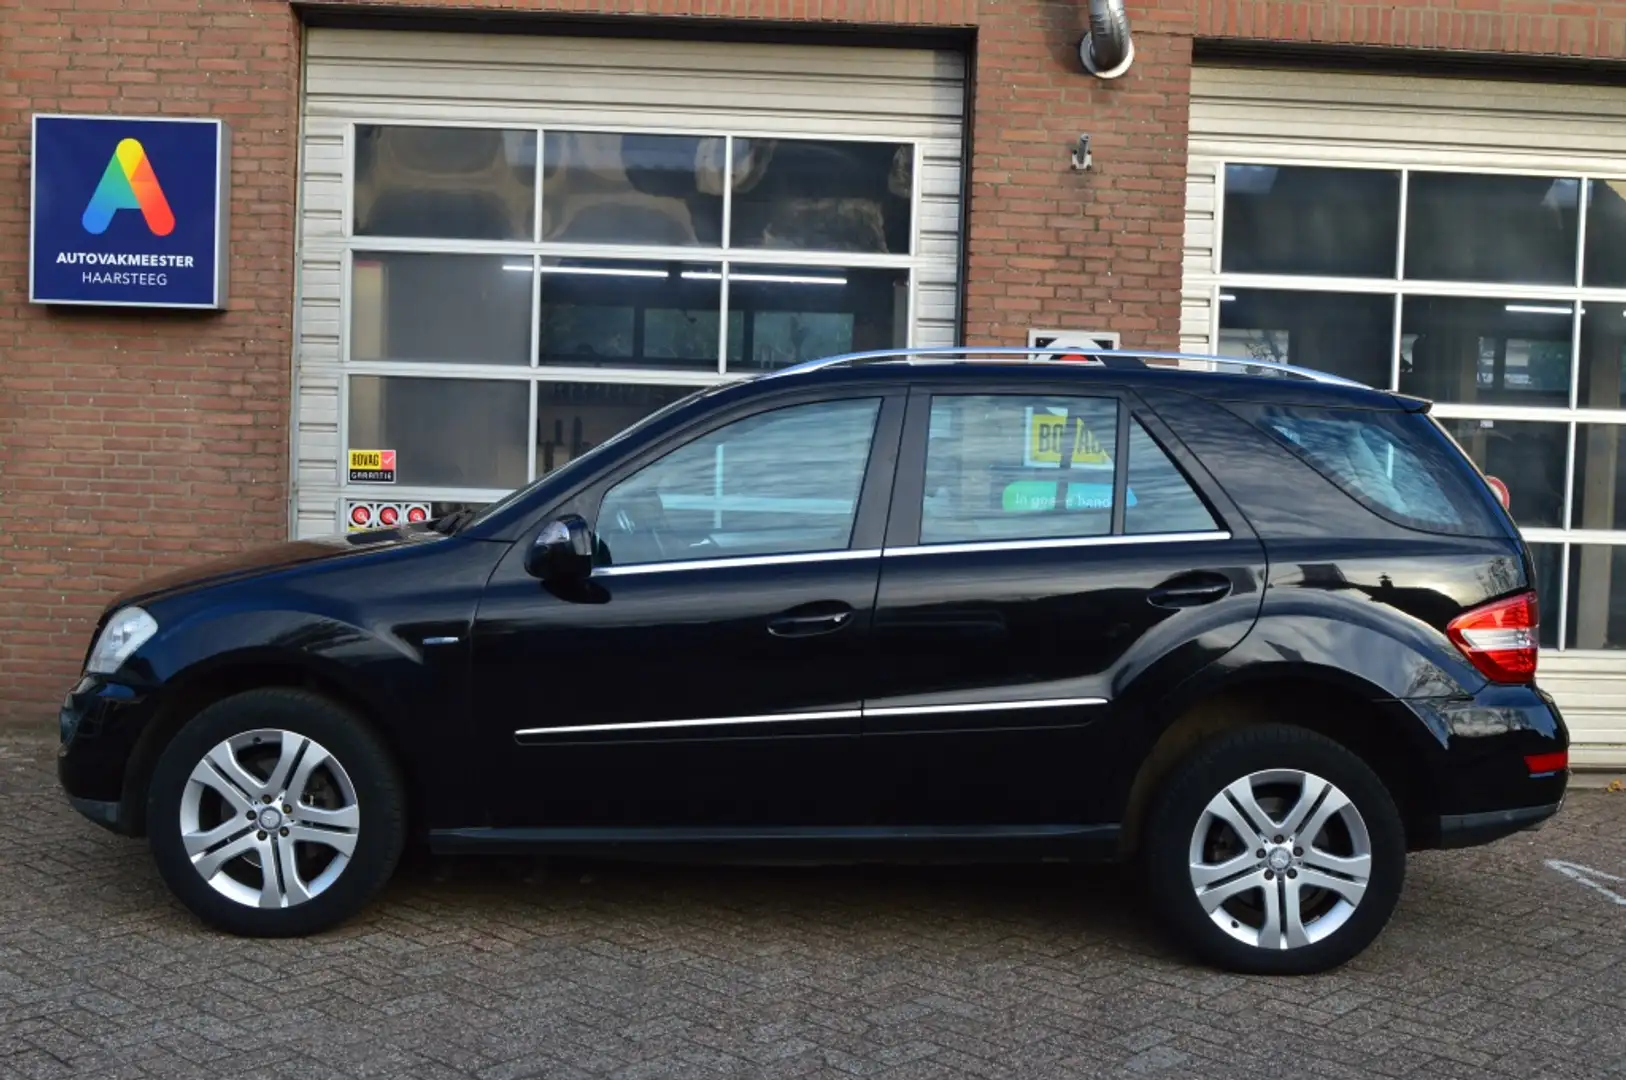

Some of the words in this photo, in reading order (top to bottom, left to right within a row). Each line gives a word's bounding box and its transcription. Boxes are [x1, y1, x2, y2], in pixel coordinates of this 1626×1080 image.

[56, 252, 194, 268] AUTOVAKMEESTER
[82, 271, 168, 286] HAARSTEEG
[351, 453, 380, 467] BOVAG
[351, 471, 392, 480] GARANTIE
